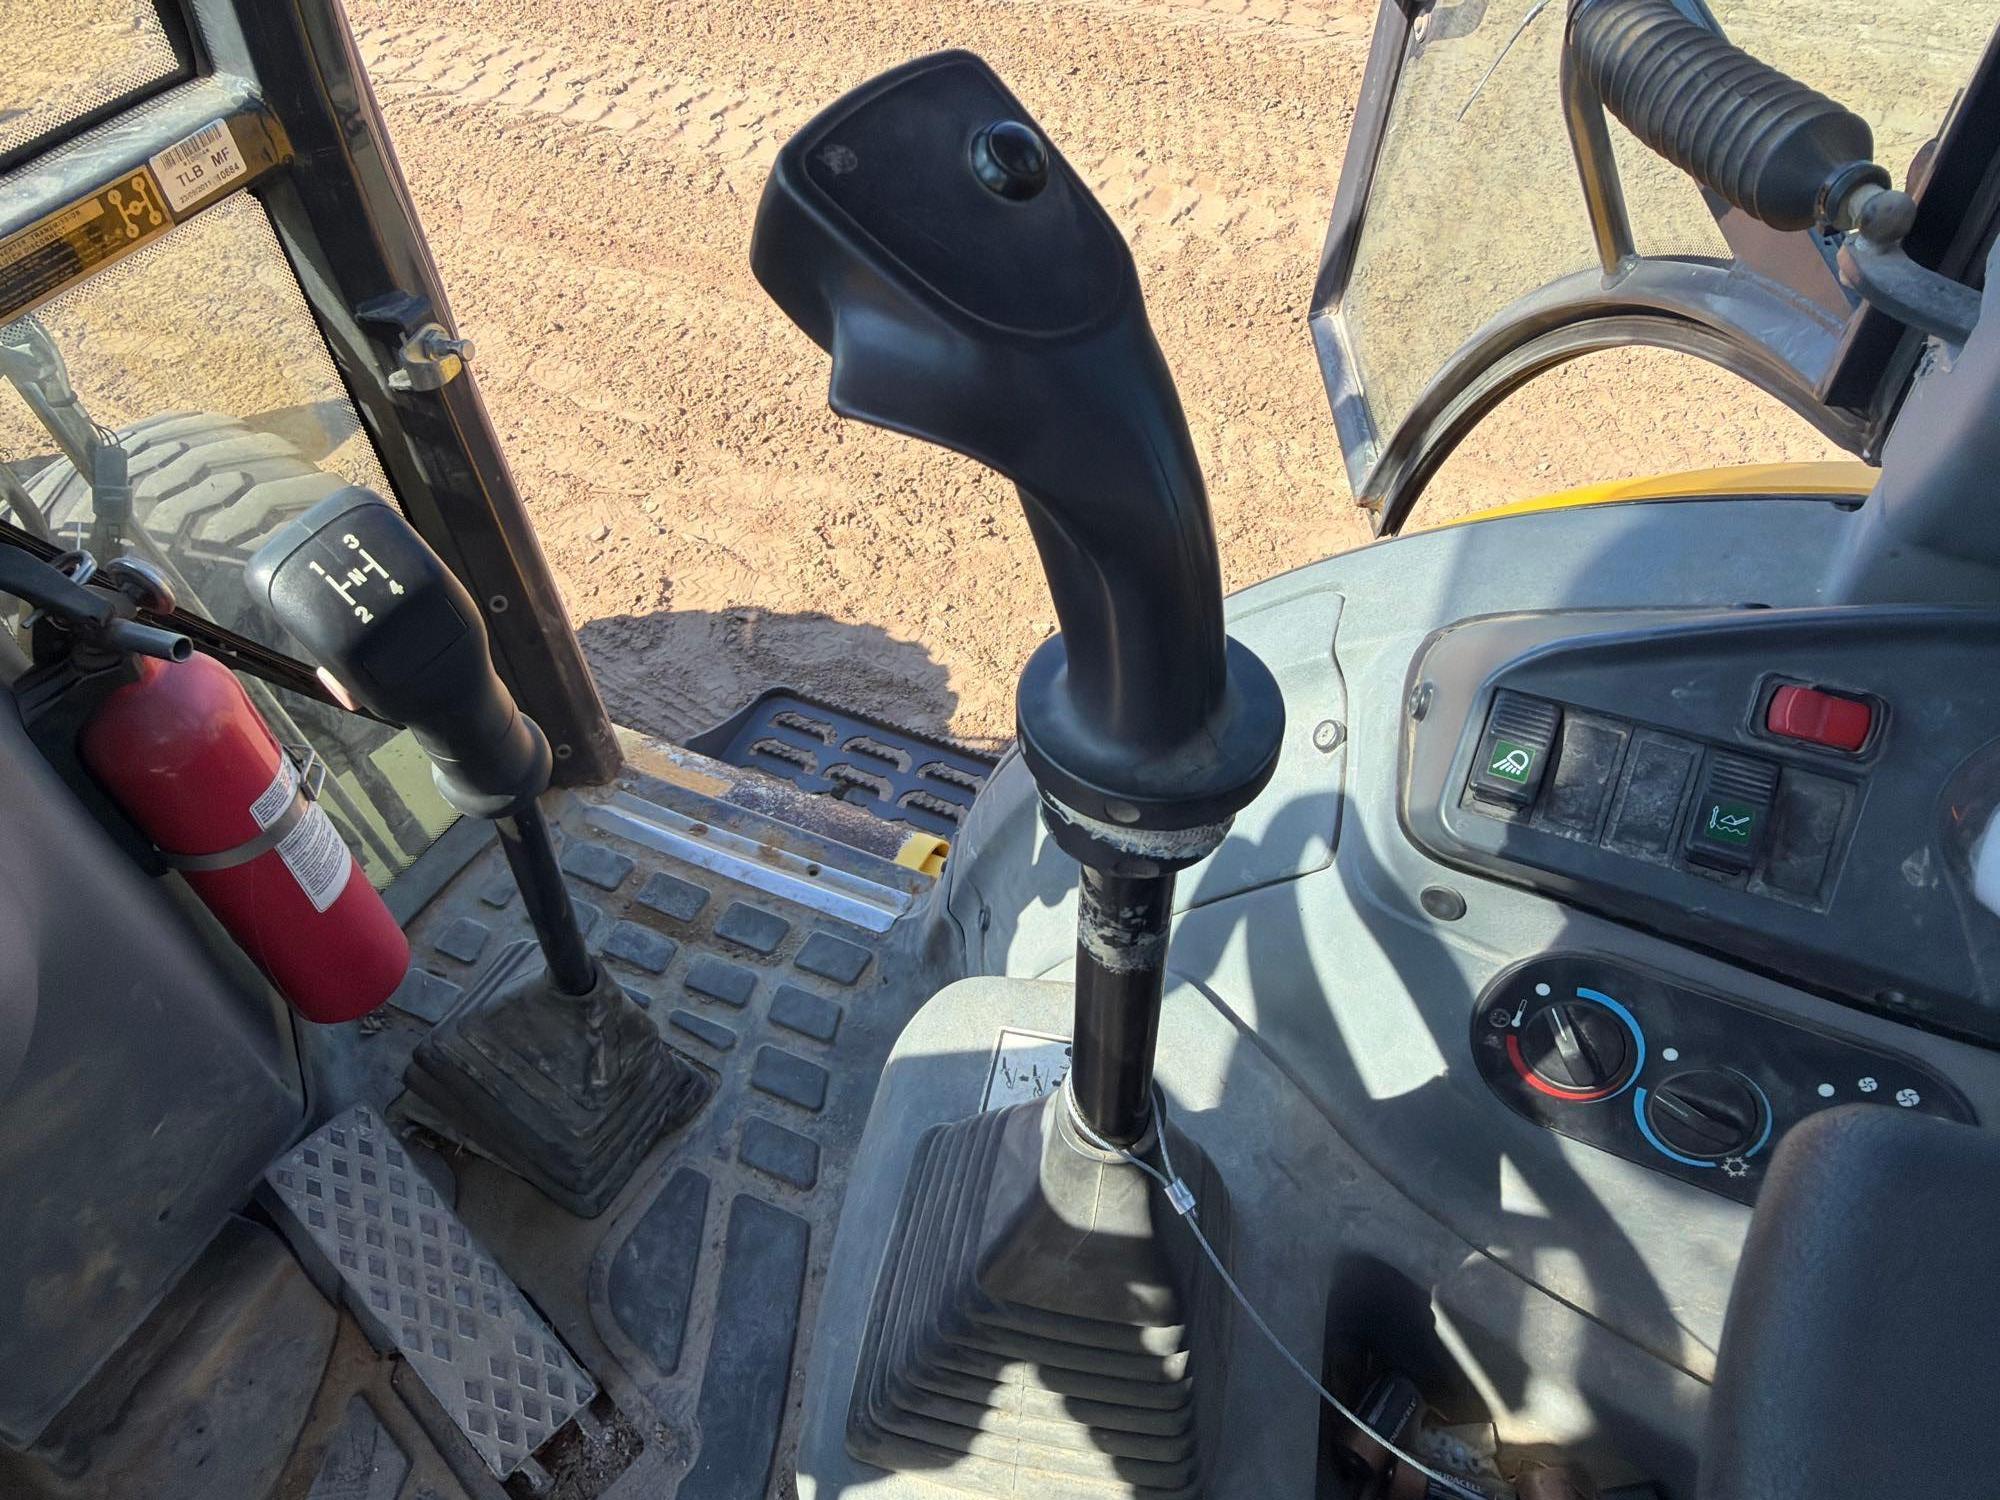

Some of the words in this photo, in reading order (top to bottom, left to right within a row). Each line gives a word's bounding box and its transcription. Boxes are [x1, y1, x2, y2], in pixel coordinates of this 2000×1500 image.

[176, 164, 204, 187] TLB
[211, 146, 229, 167] MF
[343, 534, 359, 549] 3
[309, 561, 325, 575] 1
[347, 568, 367, 586] N
[389, 580, 404, 595] 4
[354, 606, 374, 624] 2
